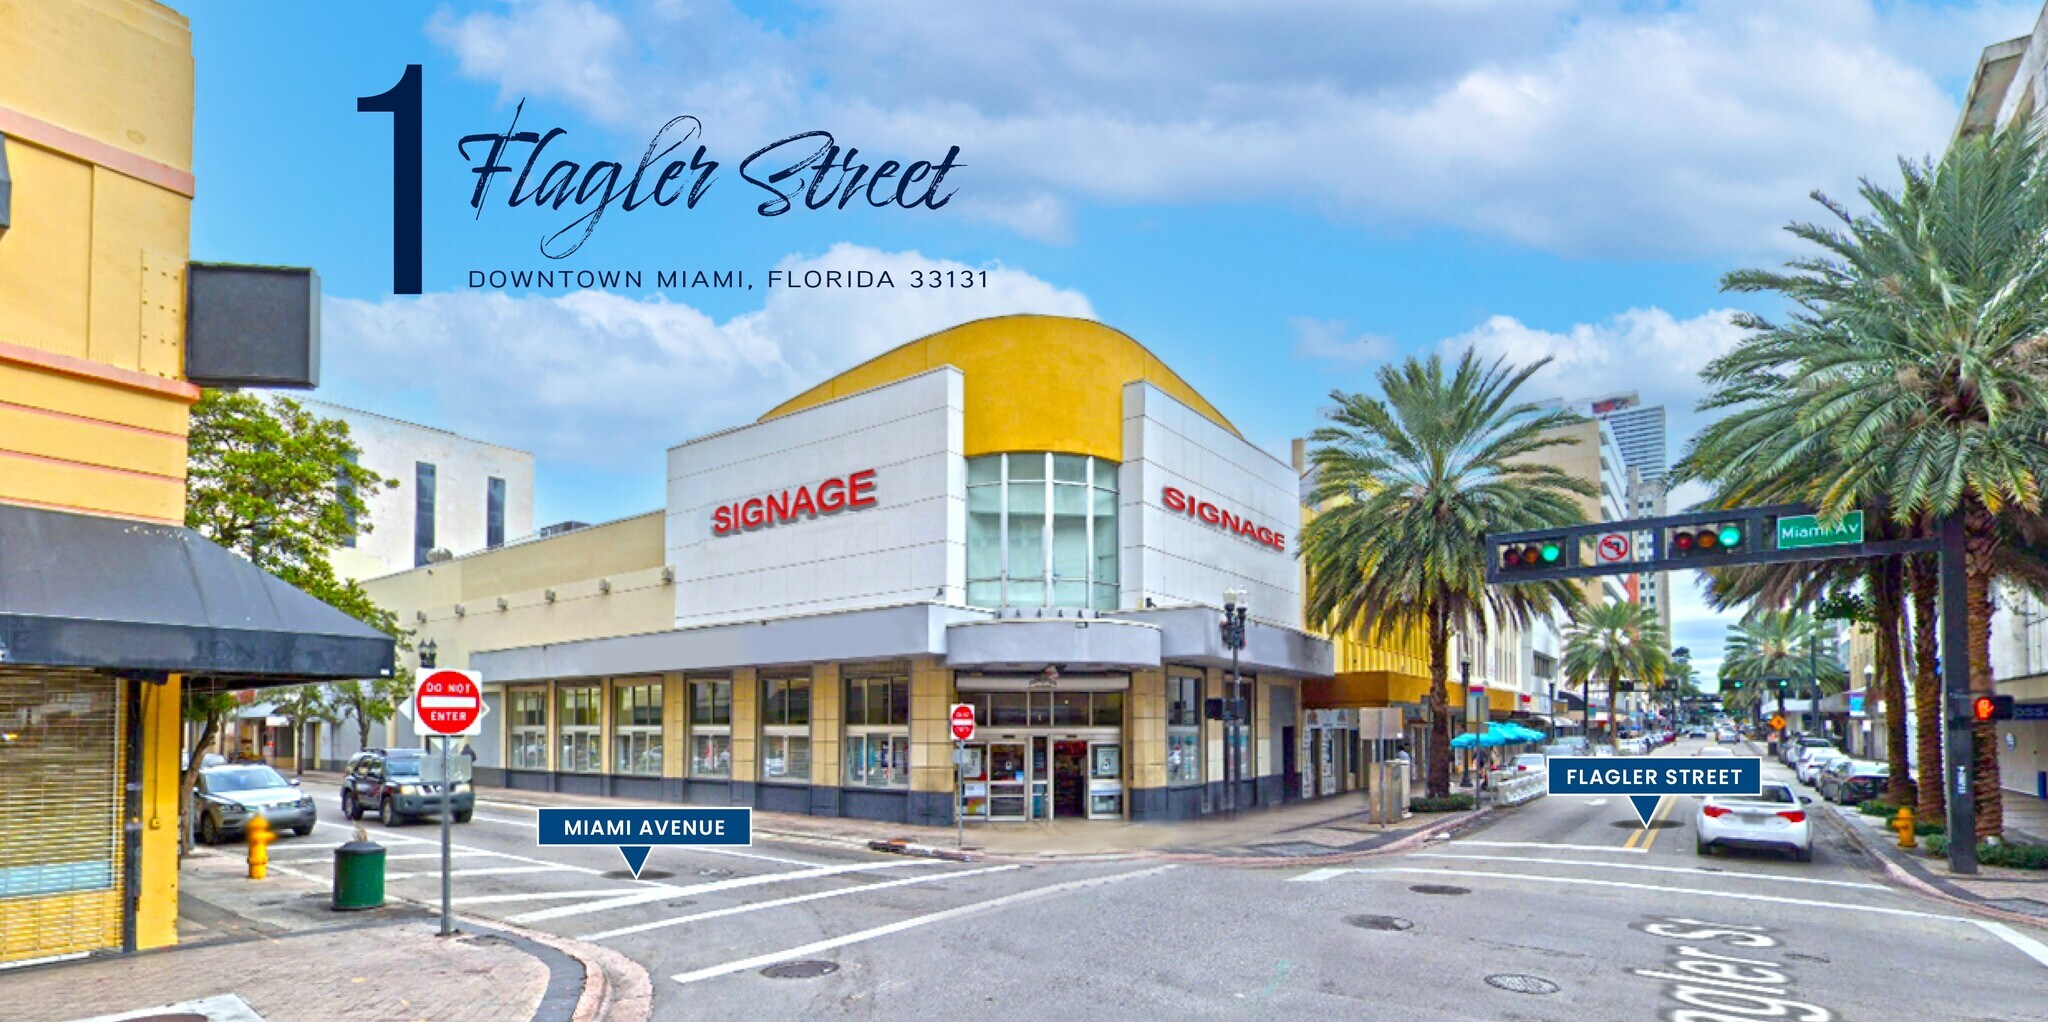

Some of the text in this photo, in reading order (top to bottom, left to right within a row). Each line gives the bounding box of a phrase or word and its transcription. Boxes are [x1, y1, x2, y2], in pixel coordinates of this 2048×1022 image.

[713, 469, 876, 534] SIGNAGE
[1163, 487, 1285, 551] SIGNAGE
[1782, 522, 1859, 539] Miami Av
[426, 682, 471, 693] DO NOT
[430, 711, 467, 721] ENTER
